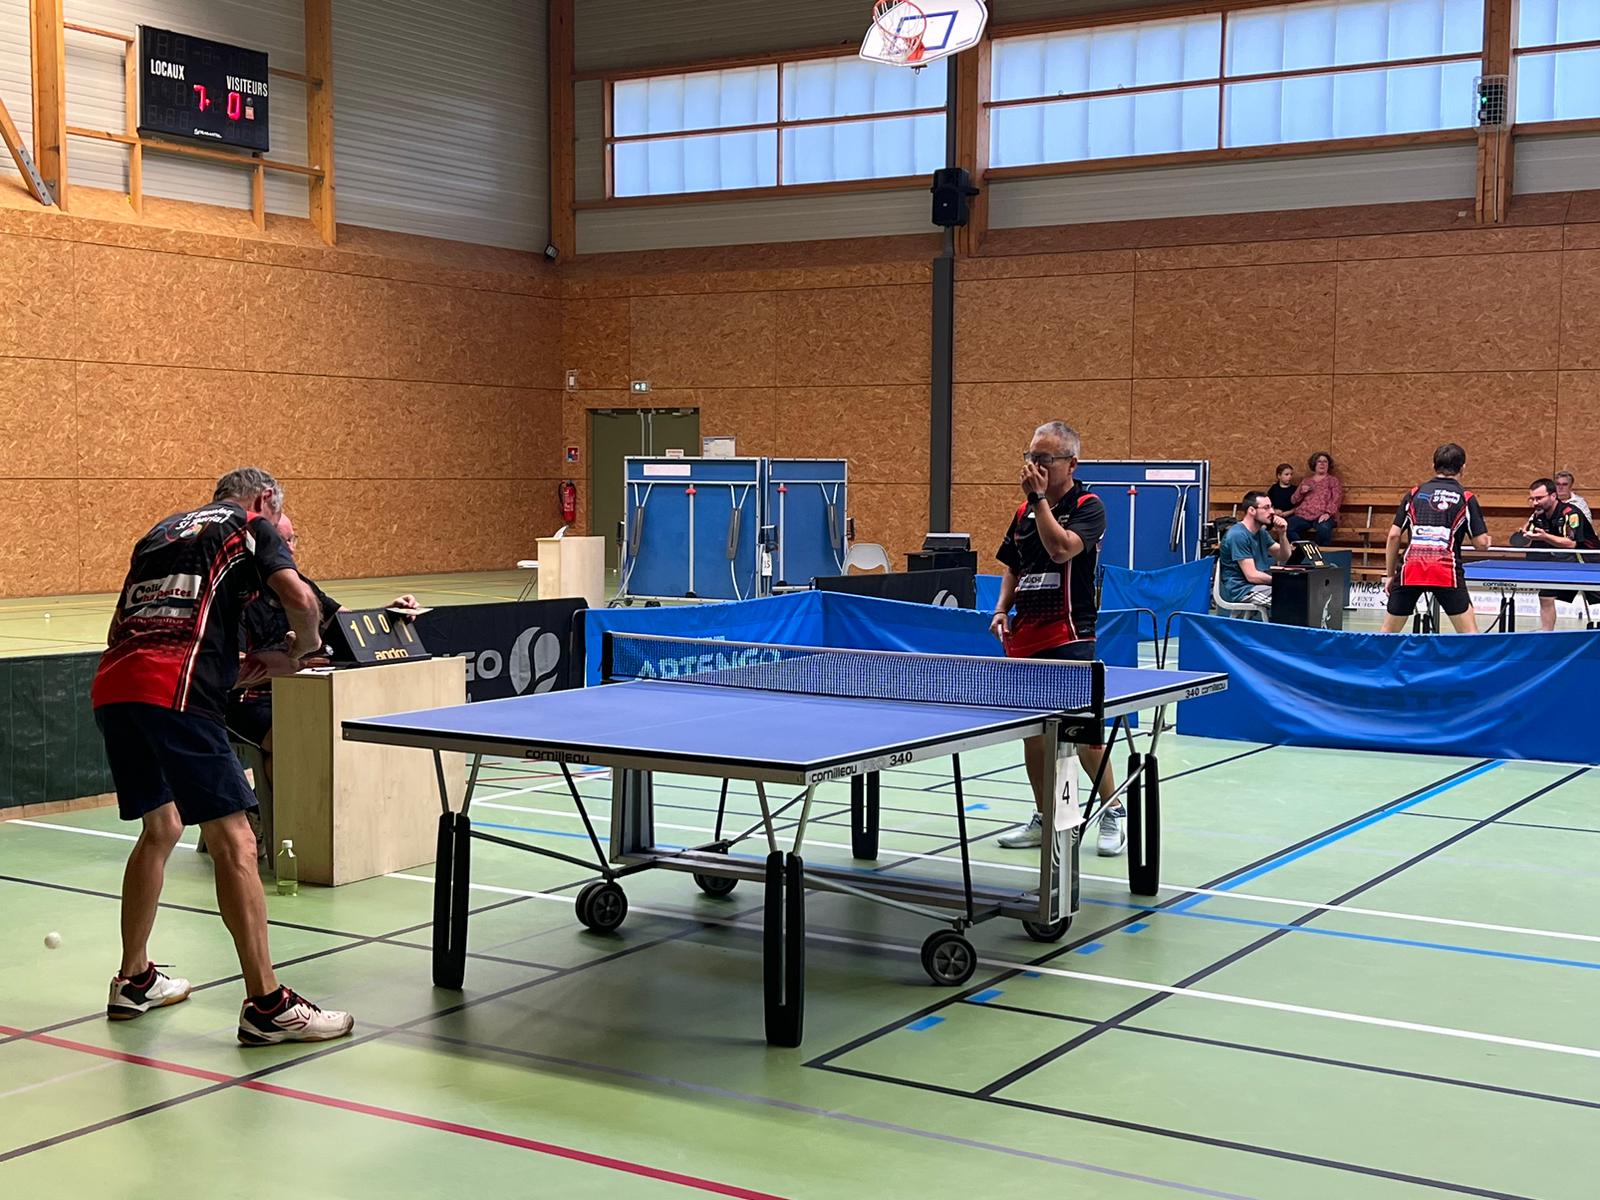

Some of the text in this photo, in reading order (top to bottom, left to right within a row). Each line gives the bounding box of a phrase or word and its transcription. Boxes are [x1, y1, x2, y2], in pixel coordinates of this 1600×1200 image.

[150, 58, 185, 80] LOCAUX
[226, 75, 268, 97] VISITEURS
[1185, 687, 1200, 698] 340
[525, 749, 590, 763] cornilleau
[812, 765, 857, 783] cornilleau
[889, 751, 913, 766] 340
[1062, 780, 1070, 805] 4
